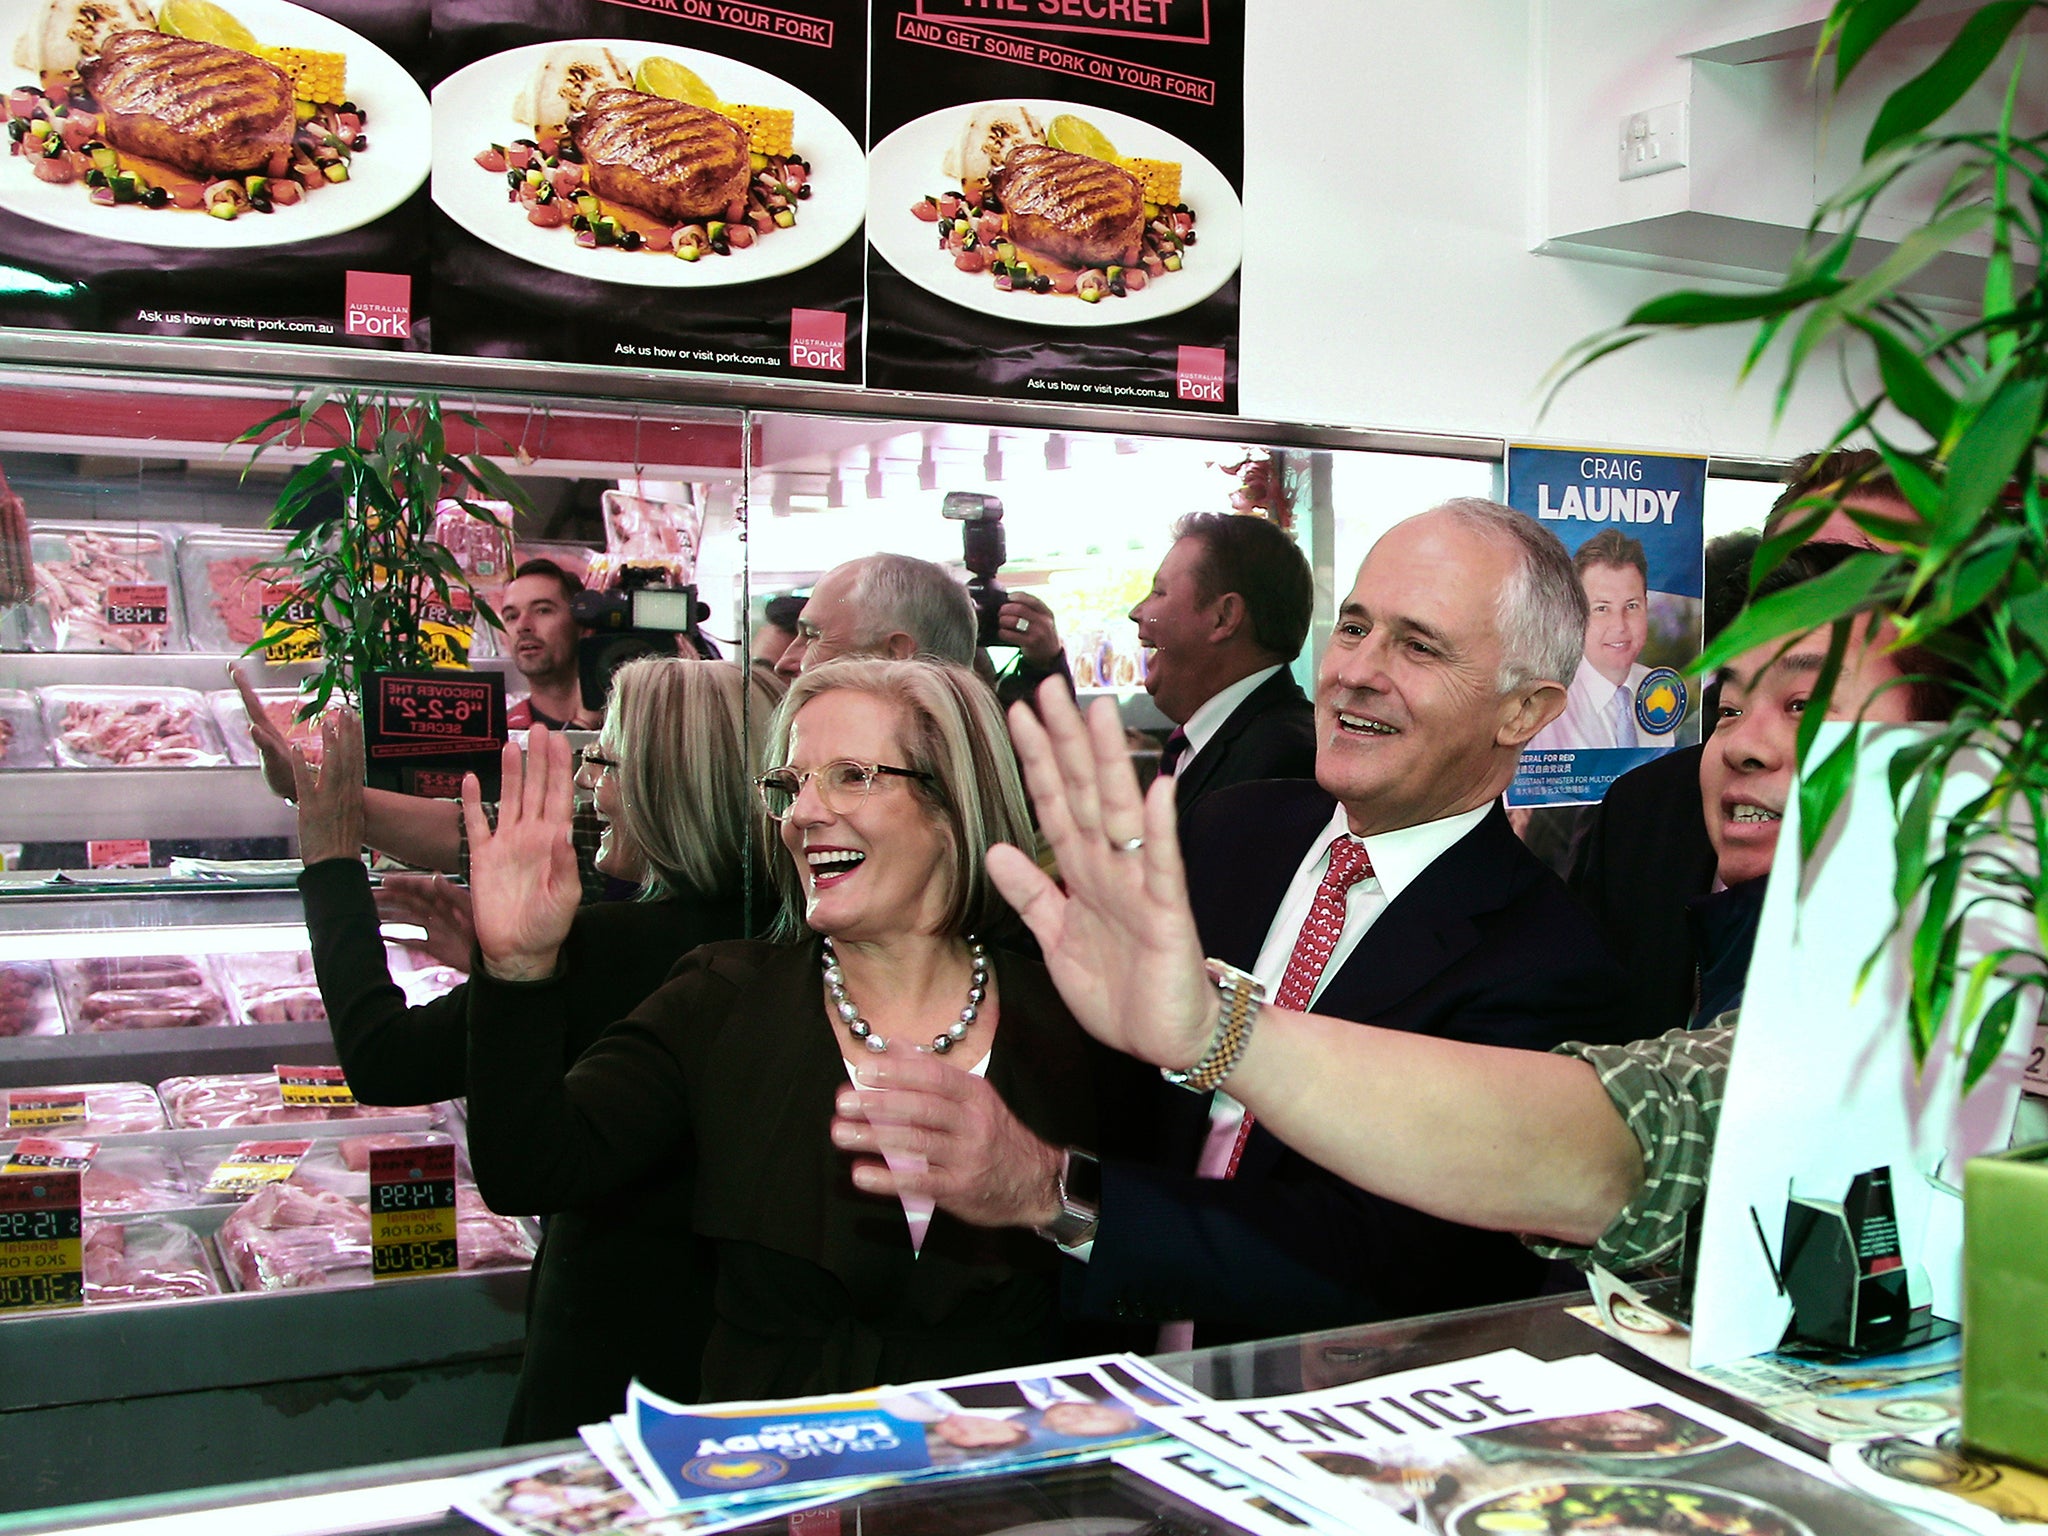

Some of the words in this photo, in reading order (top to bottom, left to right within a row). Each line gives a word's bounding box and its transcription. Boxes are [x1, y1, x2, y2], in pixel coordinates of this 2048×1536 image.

[684, 0, 711, 17] ON
[717, 4, 769, 30] YOUR
[775, 17, 825, 41] FORK
[1038, 0, 1172, 25] SECRET
[903, 21, 941, 41] AND
[946, 30, 981, 50] GET
[984, 38, 1034, 61] SOME
[1039, 48, 1085, 71] PORK
[1089, 60, 1113, 78] ON
[1116, 67, 1161, 89] YOUR
[1165, 77, 1209, 99] FORK
[350, 303, 408, 314] AUSTRALIAN
[138, 309, 163, 323] Ask
[165, 314, 181, 324] us
[184, 312, 210, 326] how
[213, 317, 227, 327] or
[230, 316, 255, 329] visit
[258, 319, 334, 334] pork.com.au
[350, 310, 407, 336] Pork
[615, 342, 636, 355] Ask
[638, 346, 651, 356] us
[654, 344, 676, 358] how
[679, 350, 690, 359] or
[693, 349, 714, 361] visit
[716, 352, 781, 367] pork.com.au
[793, 338, 843, 348] AUSTRALIAN
[793, 345, 842, 368] Pork
[1027, 378, 1046, 390] Ask
[1047, 381, 1059, 390] us
[1061, 380, 1080, 392] how
[1082, 384, 1093, 393] or
[1094, 383, 1113, 395] visit
[1114, 386, 1170, 399] pork.com.au
[1179, 379, 1222, 400] Pork
[1180, 373, 1223, 382] AUSTRALIAN
[1580, 457, 1643, 481] CRAIG
[1538, 483, 1680, 525] LAUNDY
[1519, 754, 1542, 763] BERAL
[1543, 754, 1558, 762] FOR
[1559, 753, 1576, 762] REID
[1575, 776, 1589, 784] FOR
[1237, 1379, 1535, 1444] ENTICE
[695, 1422, 893, 1457] LAUNDY
[778, 1433, 901, 1459] CRAIG
